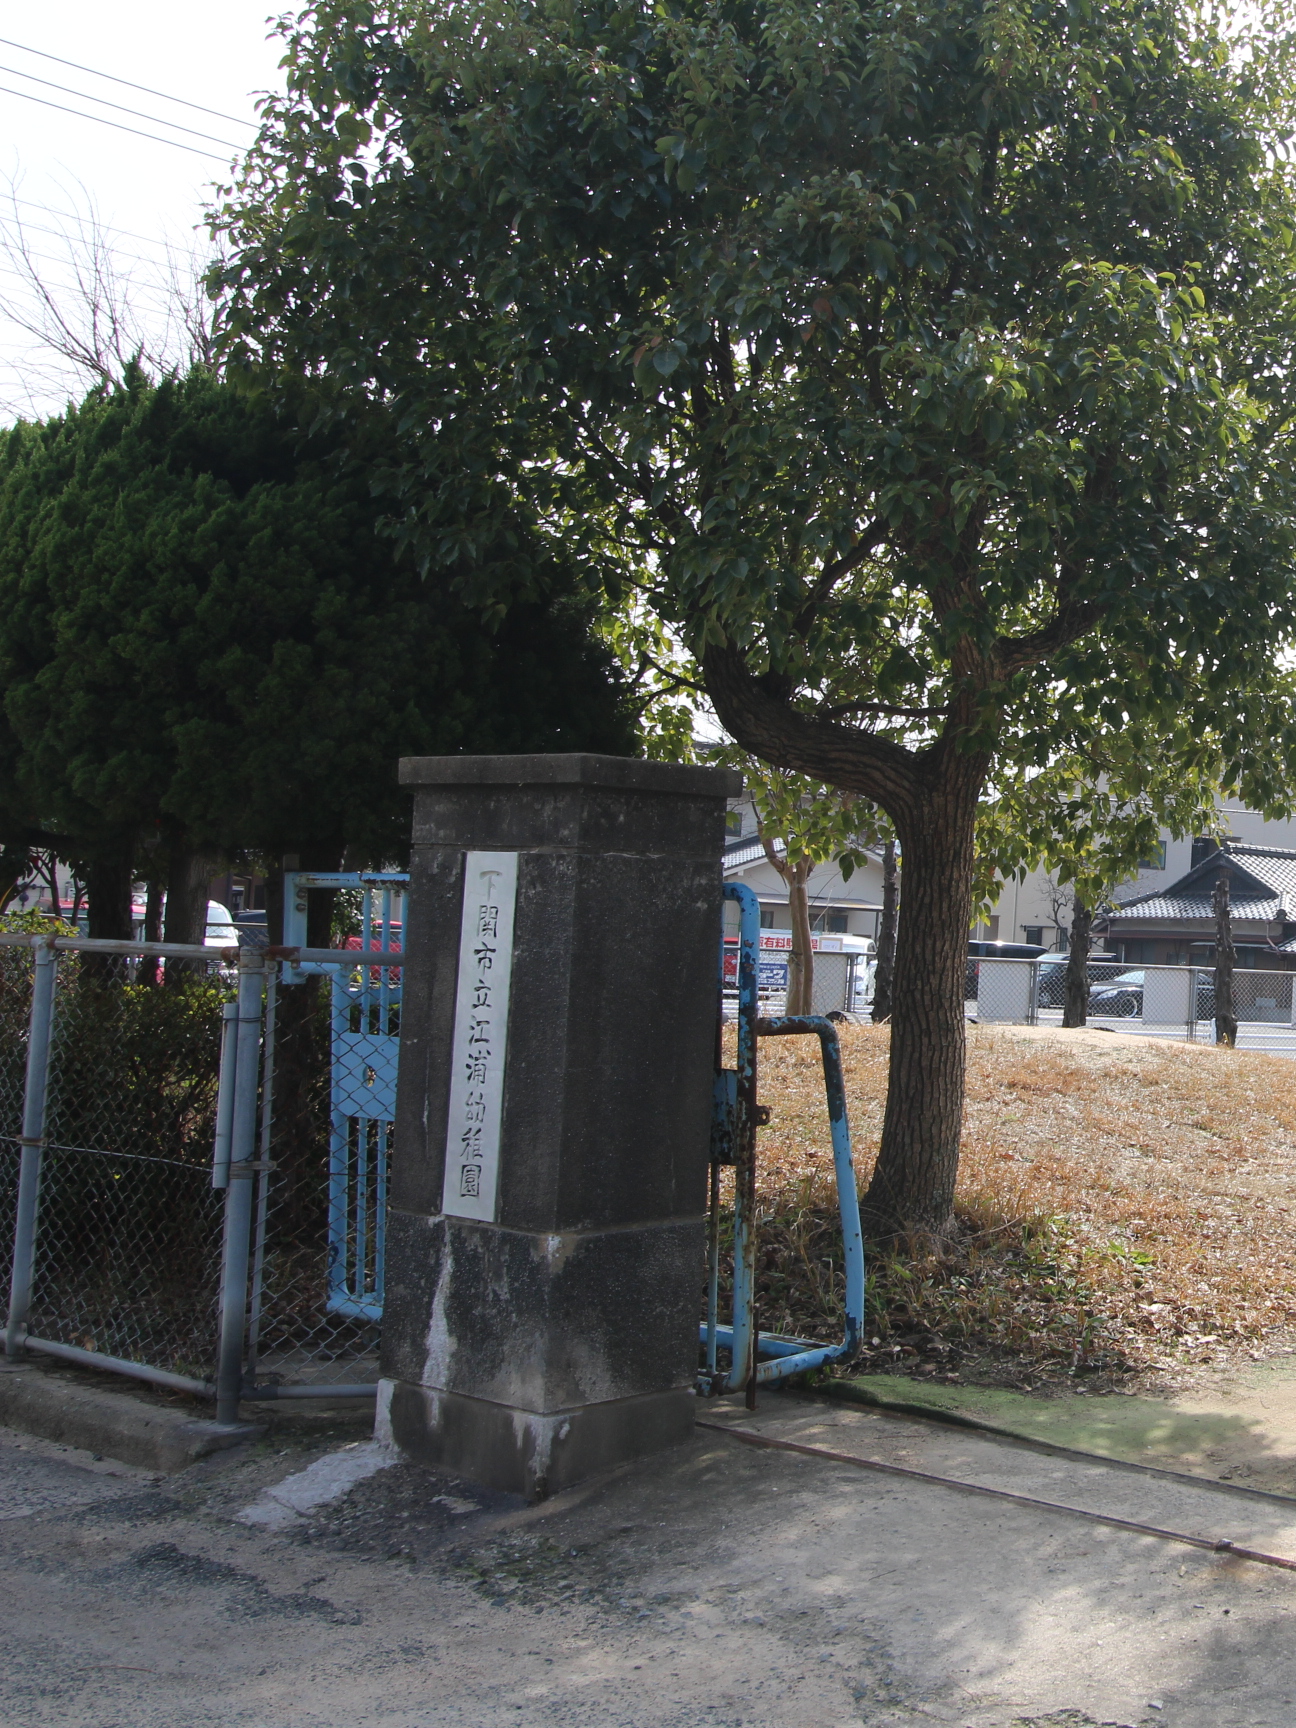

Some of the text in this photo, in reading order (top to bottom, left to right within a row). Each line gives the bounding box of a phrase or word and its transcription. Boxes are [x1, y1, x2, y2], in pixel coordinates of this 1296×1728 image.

[460, 870, 502, 1198] 下関市立江浦幼稚園
